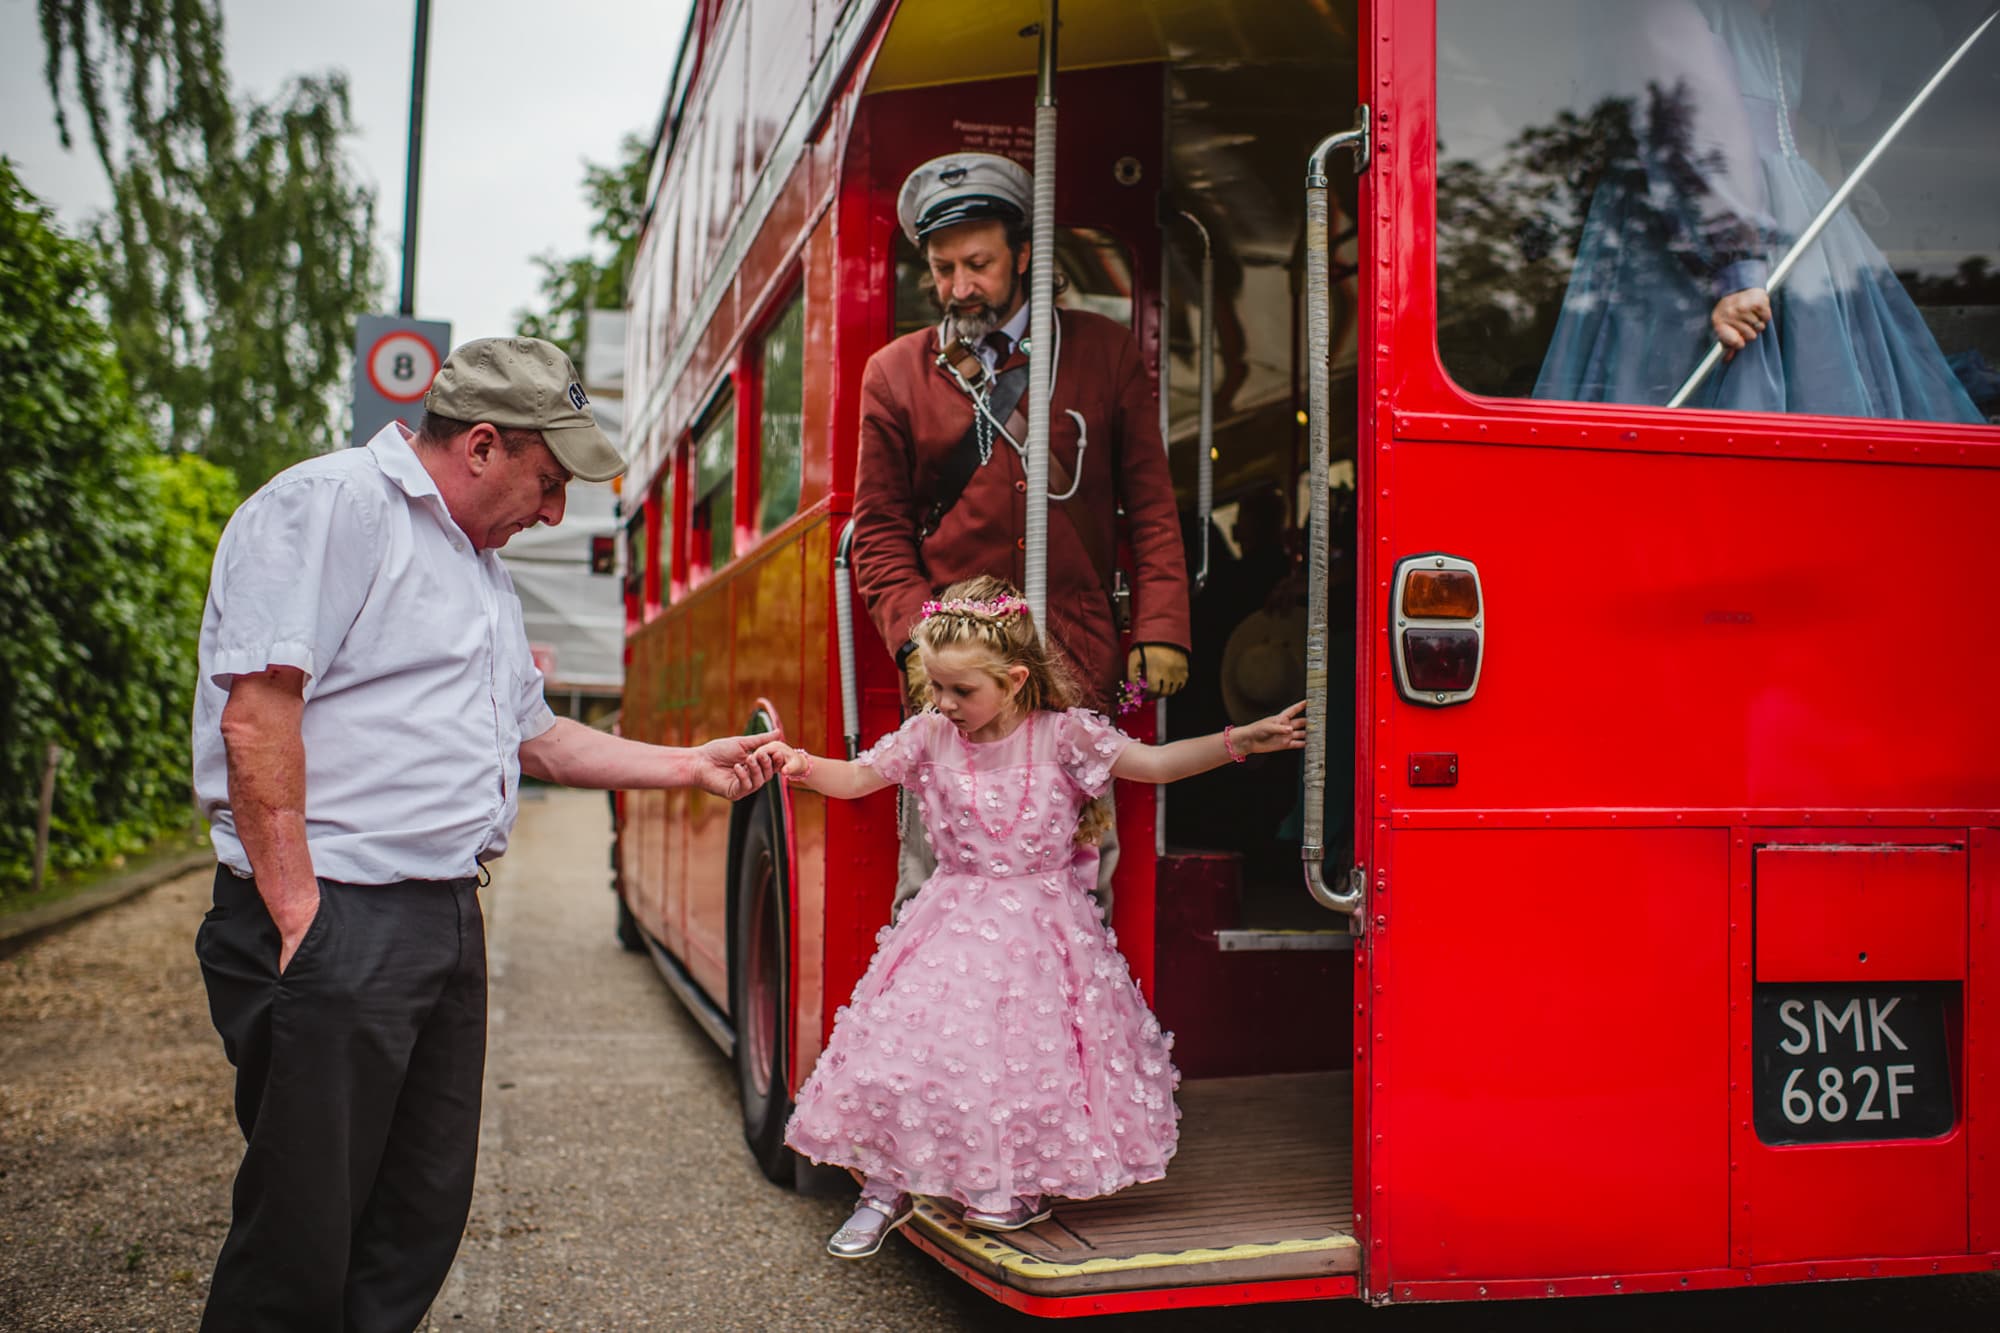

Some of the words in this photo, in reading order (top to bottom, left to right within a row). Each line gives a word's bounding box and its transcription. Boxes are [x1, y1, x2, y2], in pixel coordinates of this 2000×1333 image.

[393, 353, 415, 381] 8
[1779, 997, 1909, 1055] SMK
[1781, 1064, 1916, 1125] 682F
